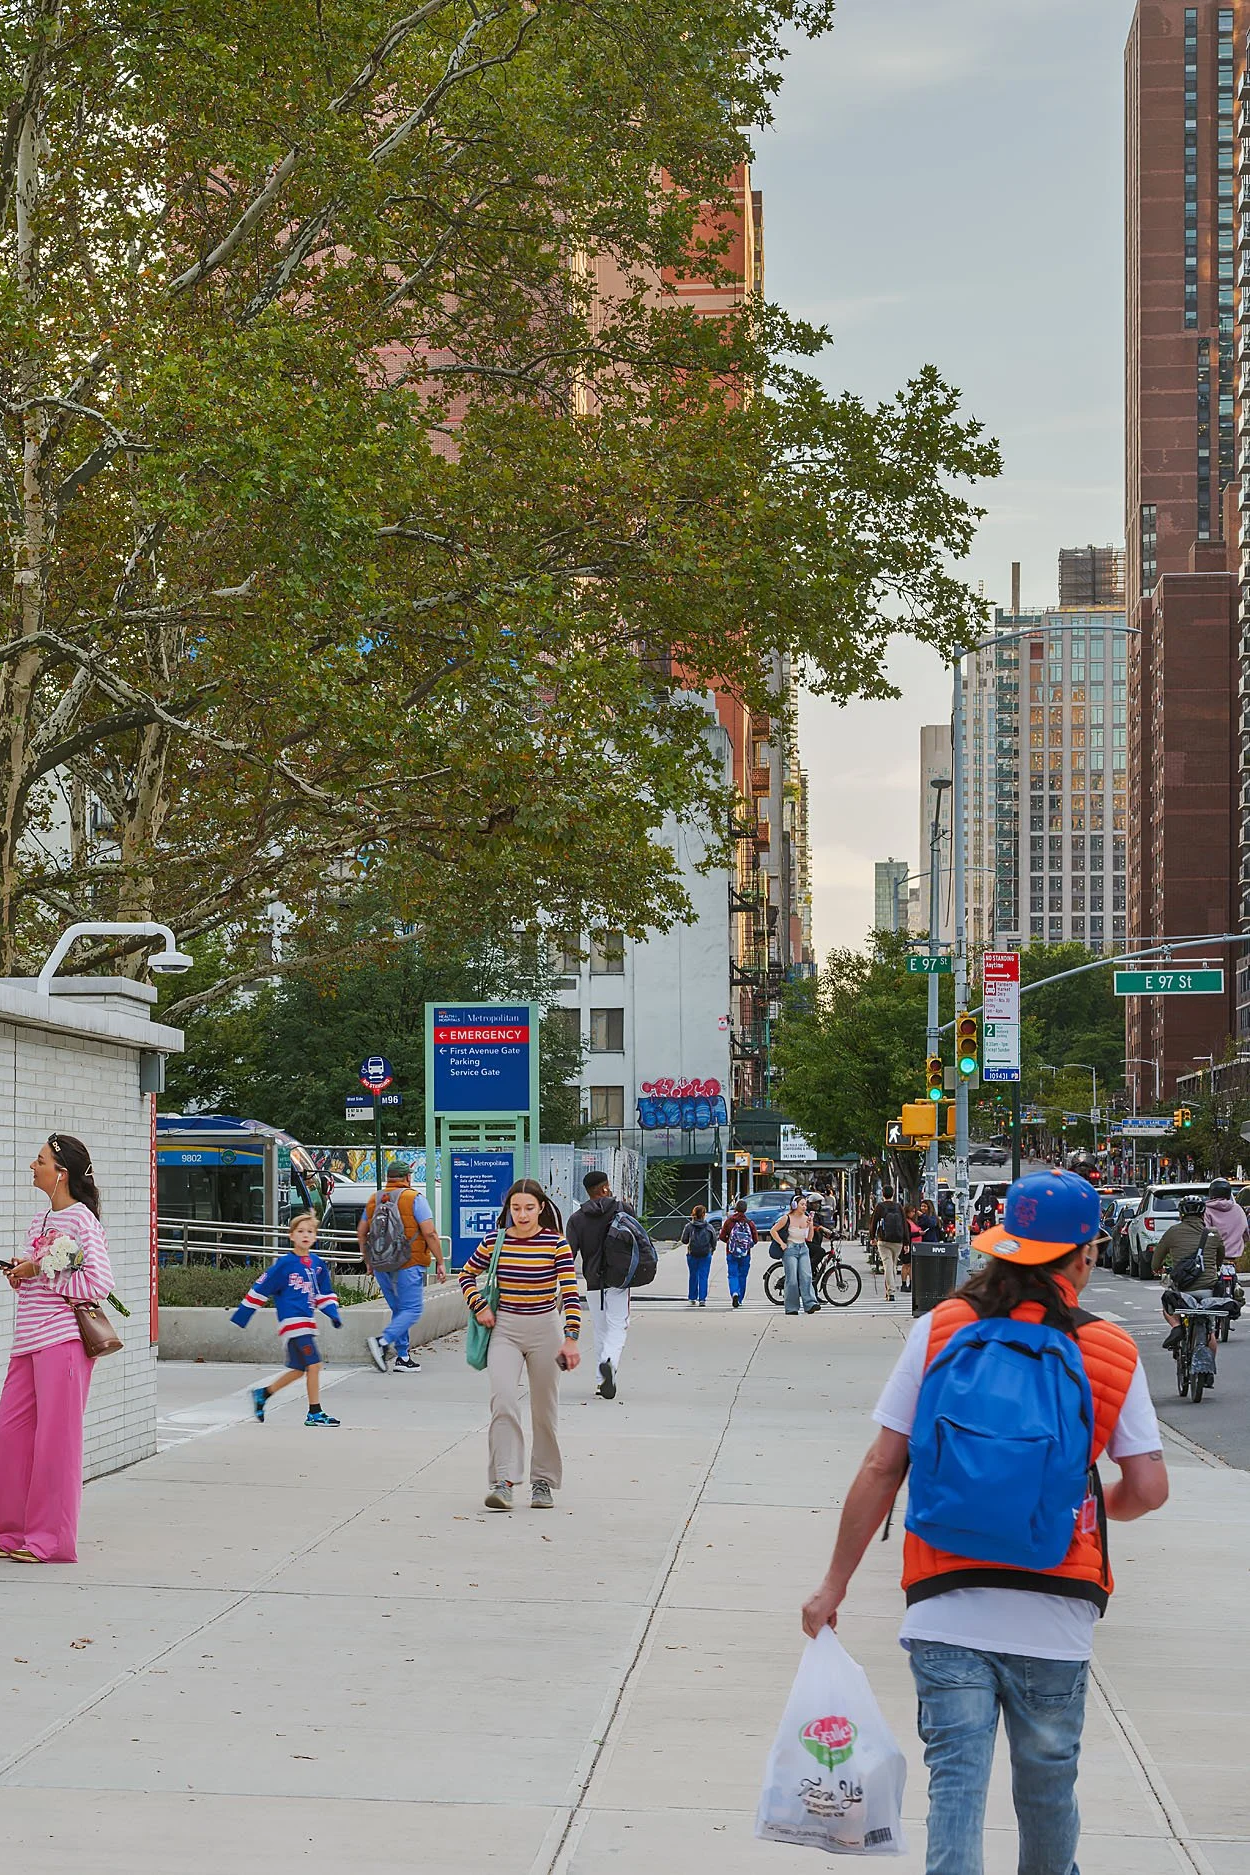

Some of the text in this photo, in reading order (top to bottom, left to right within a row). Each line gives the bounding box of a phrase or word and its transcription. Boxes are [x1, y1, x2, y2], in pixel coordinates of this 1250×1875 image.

[910, 957, 948, 970] E 97 St
[986, 962, 1004, 970] Anytime
[1146, 975, 1192, 989] E 97 St
[468, 1014, 519, 1024] Metropolitan
[987, 1024, 993, 1036] 2
[450, 1030, 522, 1040] EMERGENCY
[450, 1047, 521, 1055] First Avenue Gate
[450, 1058, 480, 1067] Parking
[450, 1068, 501, 1076] Service Gate
[363, 1079, 370, 1087] NO
[382, 1096, 399, 1104] M96
[474, 1160, 510, 1168] Metropolitan
